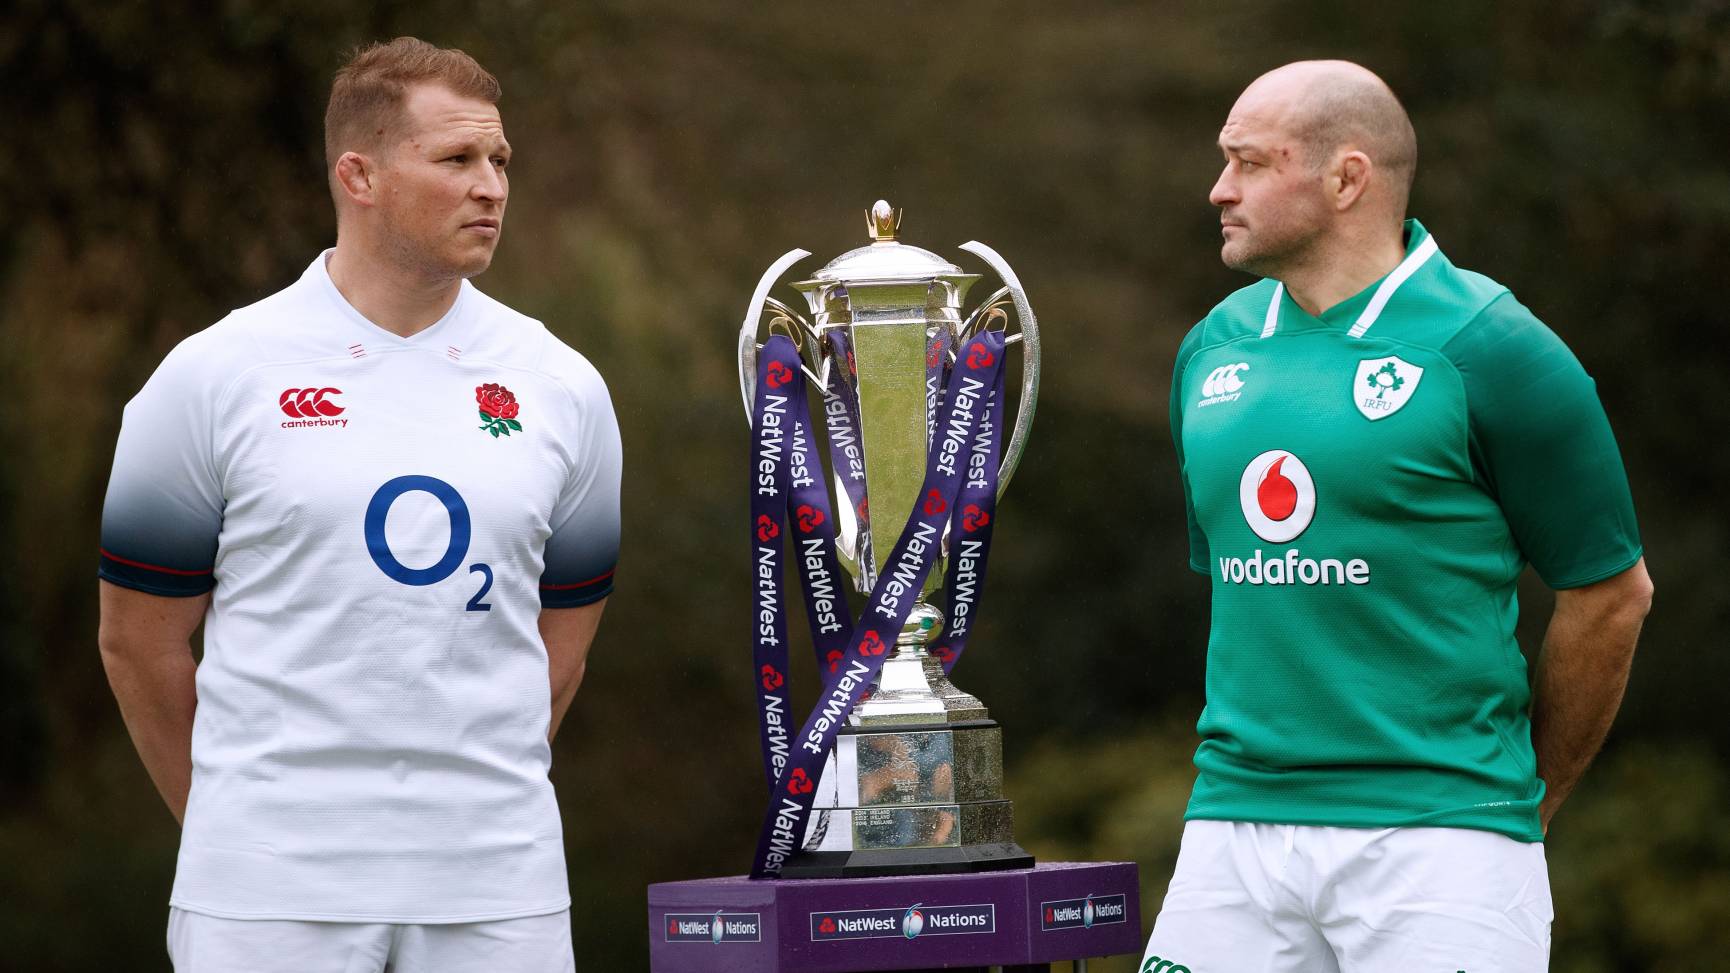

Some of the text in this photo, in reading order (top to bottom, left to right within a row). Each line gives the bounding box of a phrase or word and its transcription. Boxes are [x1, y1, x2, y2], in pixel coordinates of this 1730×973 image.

[281, 417, 348, 429] canterbury
[937, 376, 985, 477] NatWest
[966, 390, 997, 489] atWest
[1198, 391, 1242, 408] canterbury
[1363, 398, 1392, 411] IRFU
[758, 394, 788, 497] NatWest
[758, 546, 779, 647] NatWest
[802, 538, 842, 634] NatWest
[875, 521, 937, 619] NatWest
[949, 540, 983, 638] NatWest
[1219, 549, 1370, 586] vodafone
[803, 659, 870, 755] NatWest
[763, 798, 803, 874] NatWest
[678, 921, 756, 935] NatWest Nations
[838, 914, 986, 932] NatWest Nations
[1054, 903, 1122, 922] NatWest Nations
